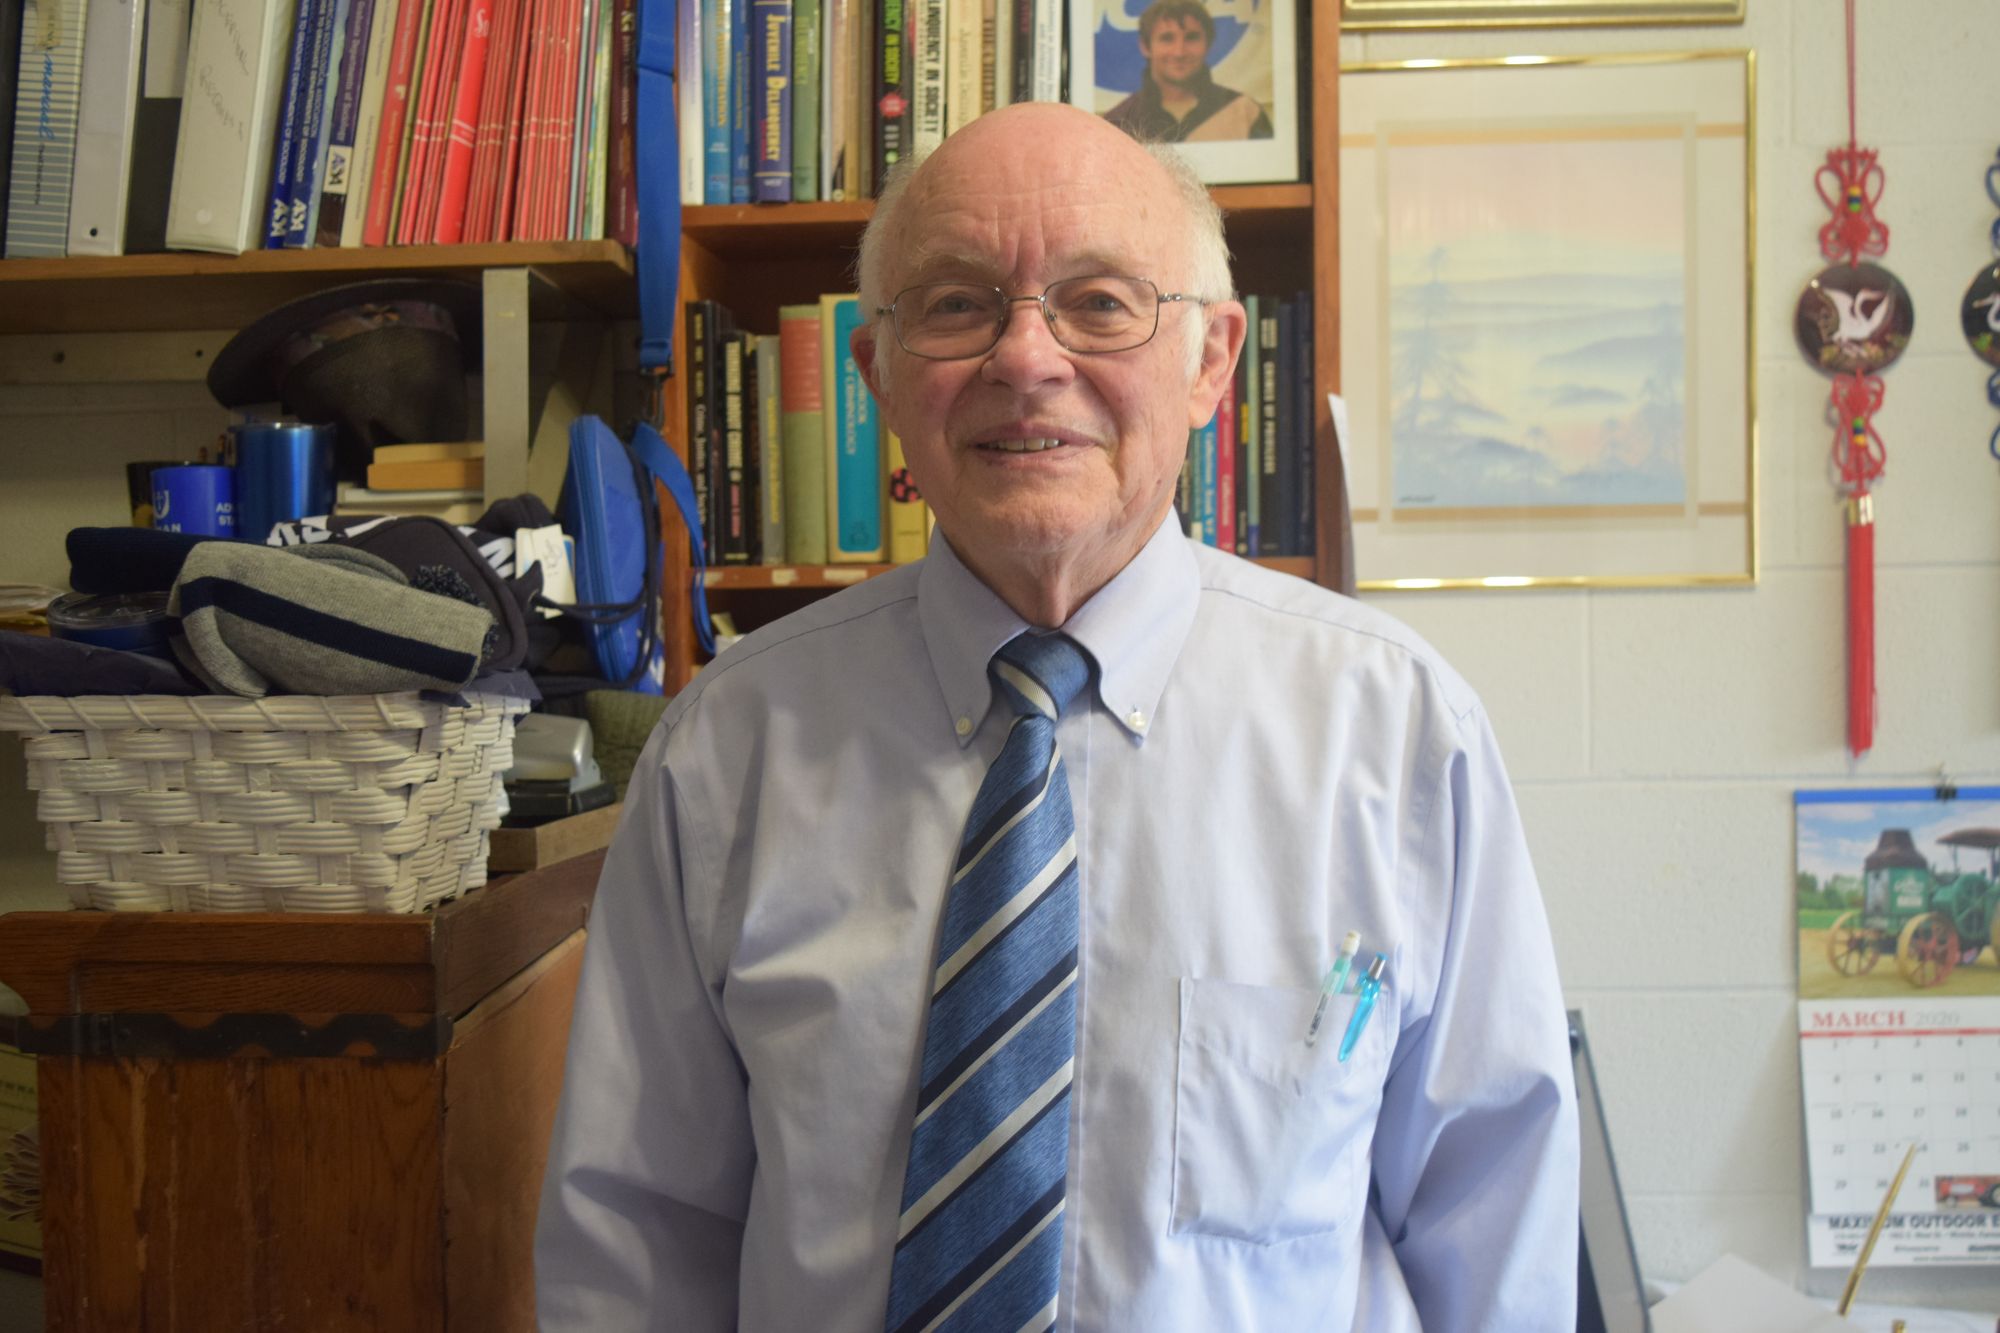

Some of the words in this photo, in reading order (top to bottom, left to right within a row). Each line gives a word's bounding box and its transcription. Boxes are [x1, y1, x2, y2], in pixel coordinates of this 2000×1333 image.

[886, 47, 901, 84] SOCIETY
[926, 69, 940, 82] IN
[766, 76, 787, 161] DELINQUENCY
[924, 86, 940, 133] SOCIETY
[328, 153, 346, 186] ASA
[270, 199, 288, 237] ASA
[289, 199, 306, 231] ASA
[1812, 1010, 1906, 1028] MARCH
[1915, 1011, 1960, 1026] 2020
[1829, 1215, 1905, 1229] MAXIUM
[1911, 1214, 1987, 1228] OUTDOOR
